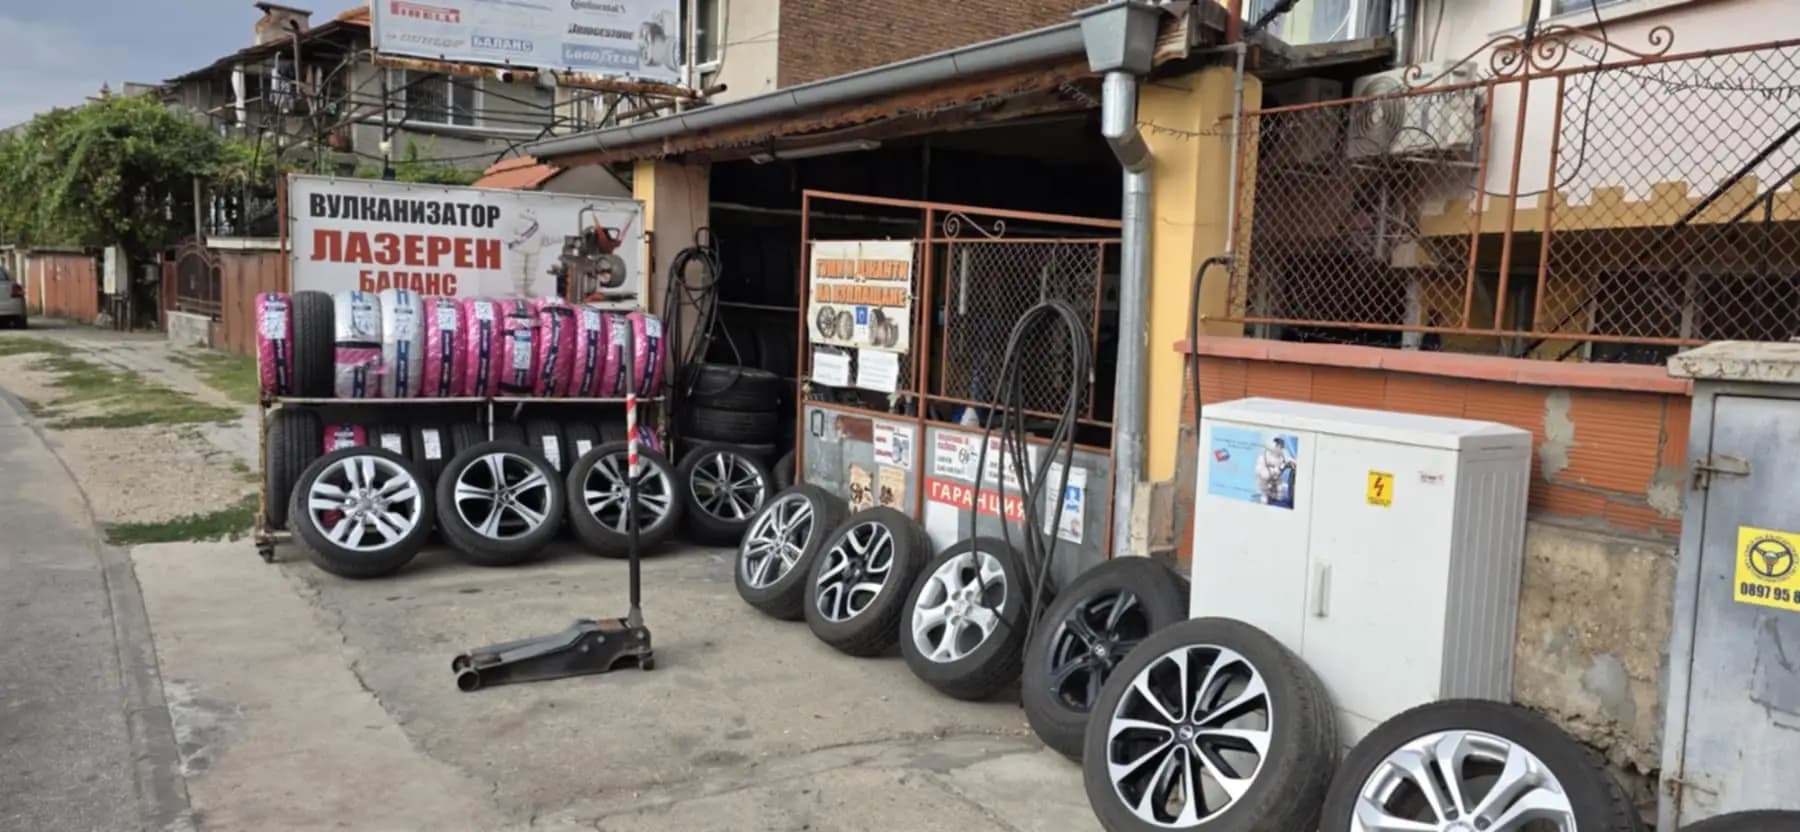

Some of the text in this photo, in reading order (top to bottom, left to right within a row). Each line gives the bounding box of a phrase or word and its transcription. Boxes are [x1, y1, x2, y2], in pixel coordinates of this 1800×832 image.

[390, 1, 460, 23] PIRELLI
[568, 23, 634, 40] BRIDGESTONE
[310, 193, 500, 228] ВУЛКАНИЗАТОР
[310, 229, 502, 270] ЛАЗЕРЕН
[931, 482, 1026, 520] ГАРАНЦИЯ
[1740, 581, 1771, 599] 0897
[1773, 585, 1790, 602] 95
